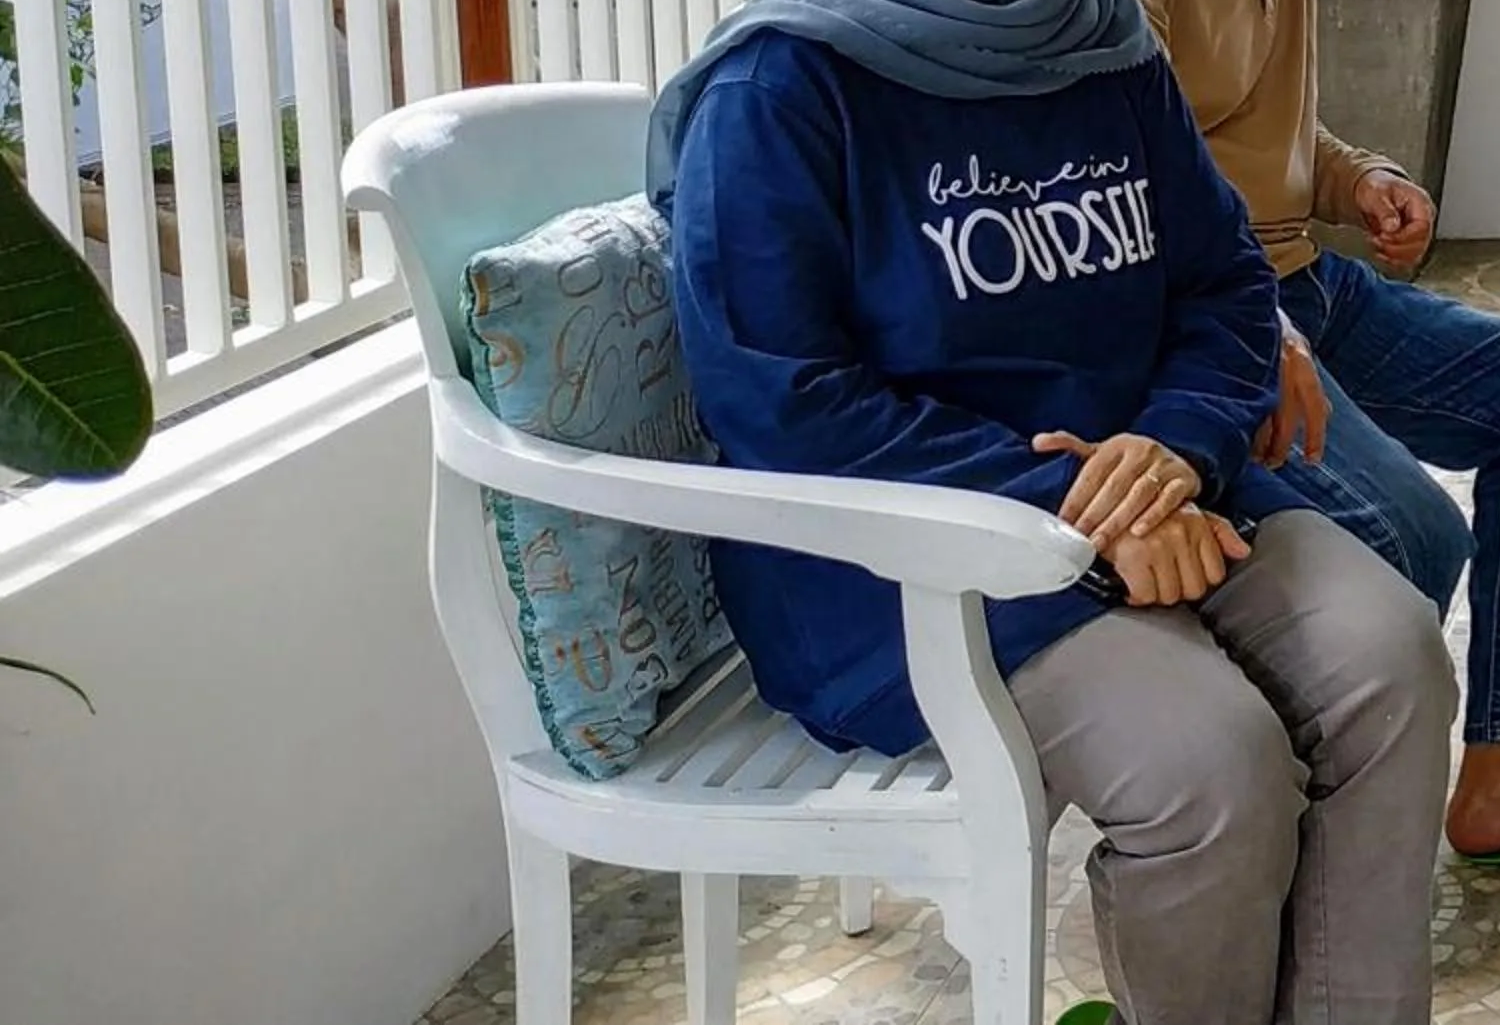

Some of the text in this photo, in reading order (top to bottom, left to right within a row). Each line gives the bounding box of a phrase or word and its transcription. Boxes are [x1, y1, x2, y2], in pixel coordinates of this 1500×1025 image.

[929, 154, 1129, 205] believe in
[921, 179, 1156, 300] YOURSELF
